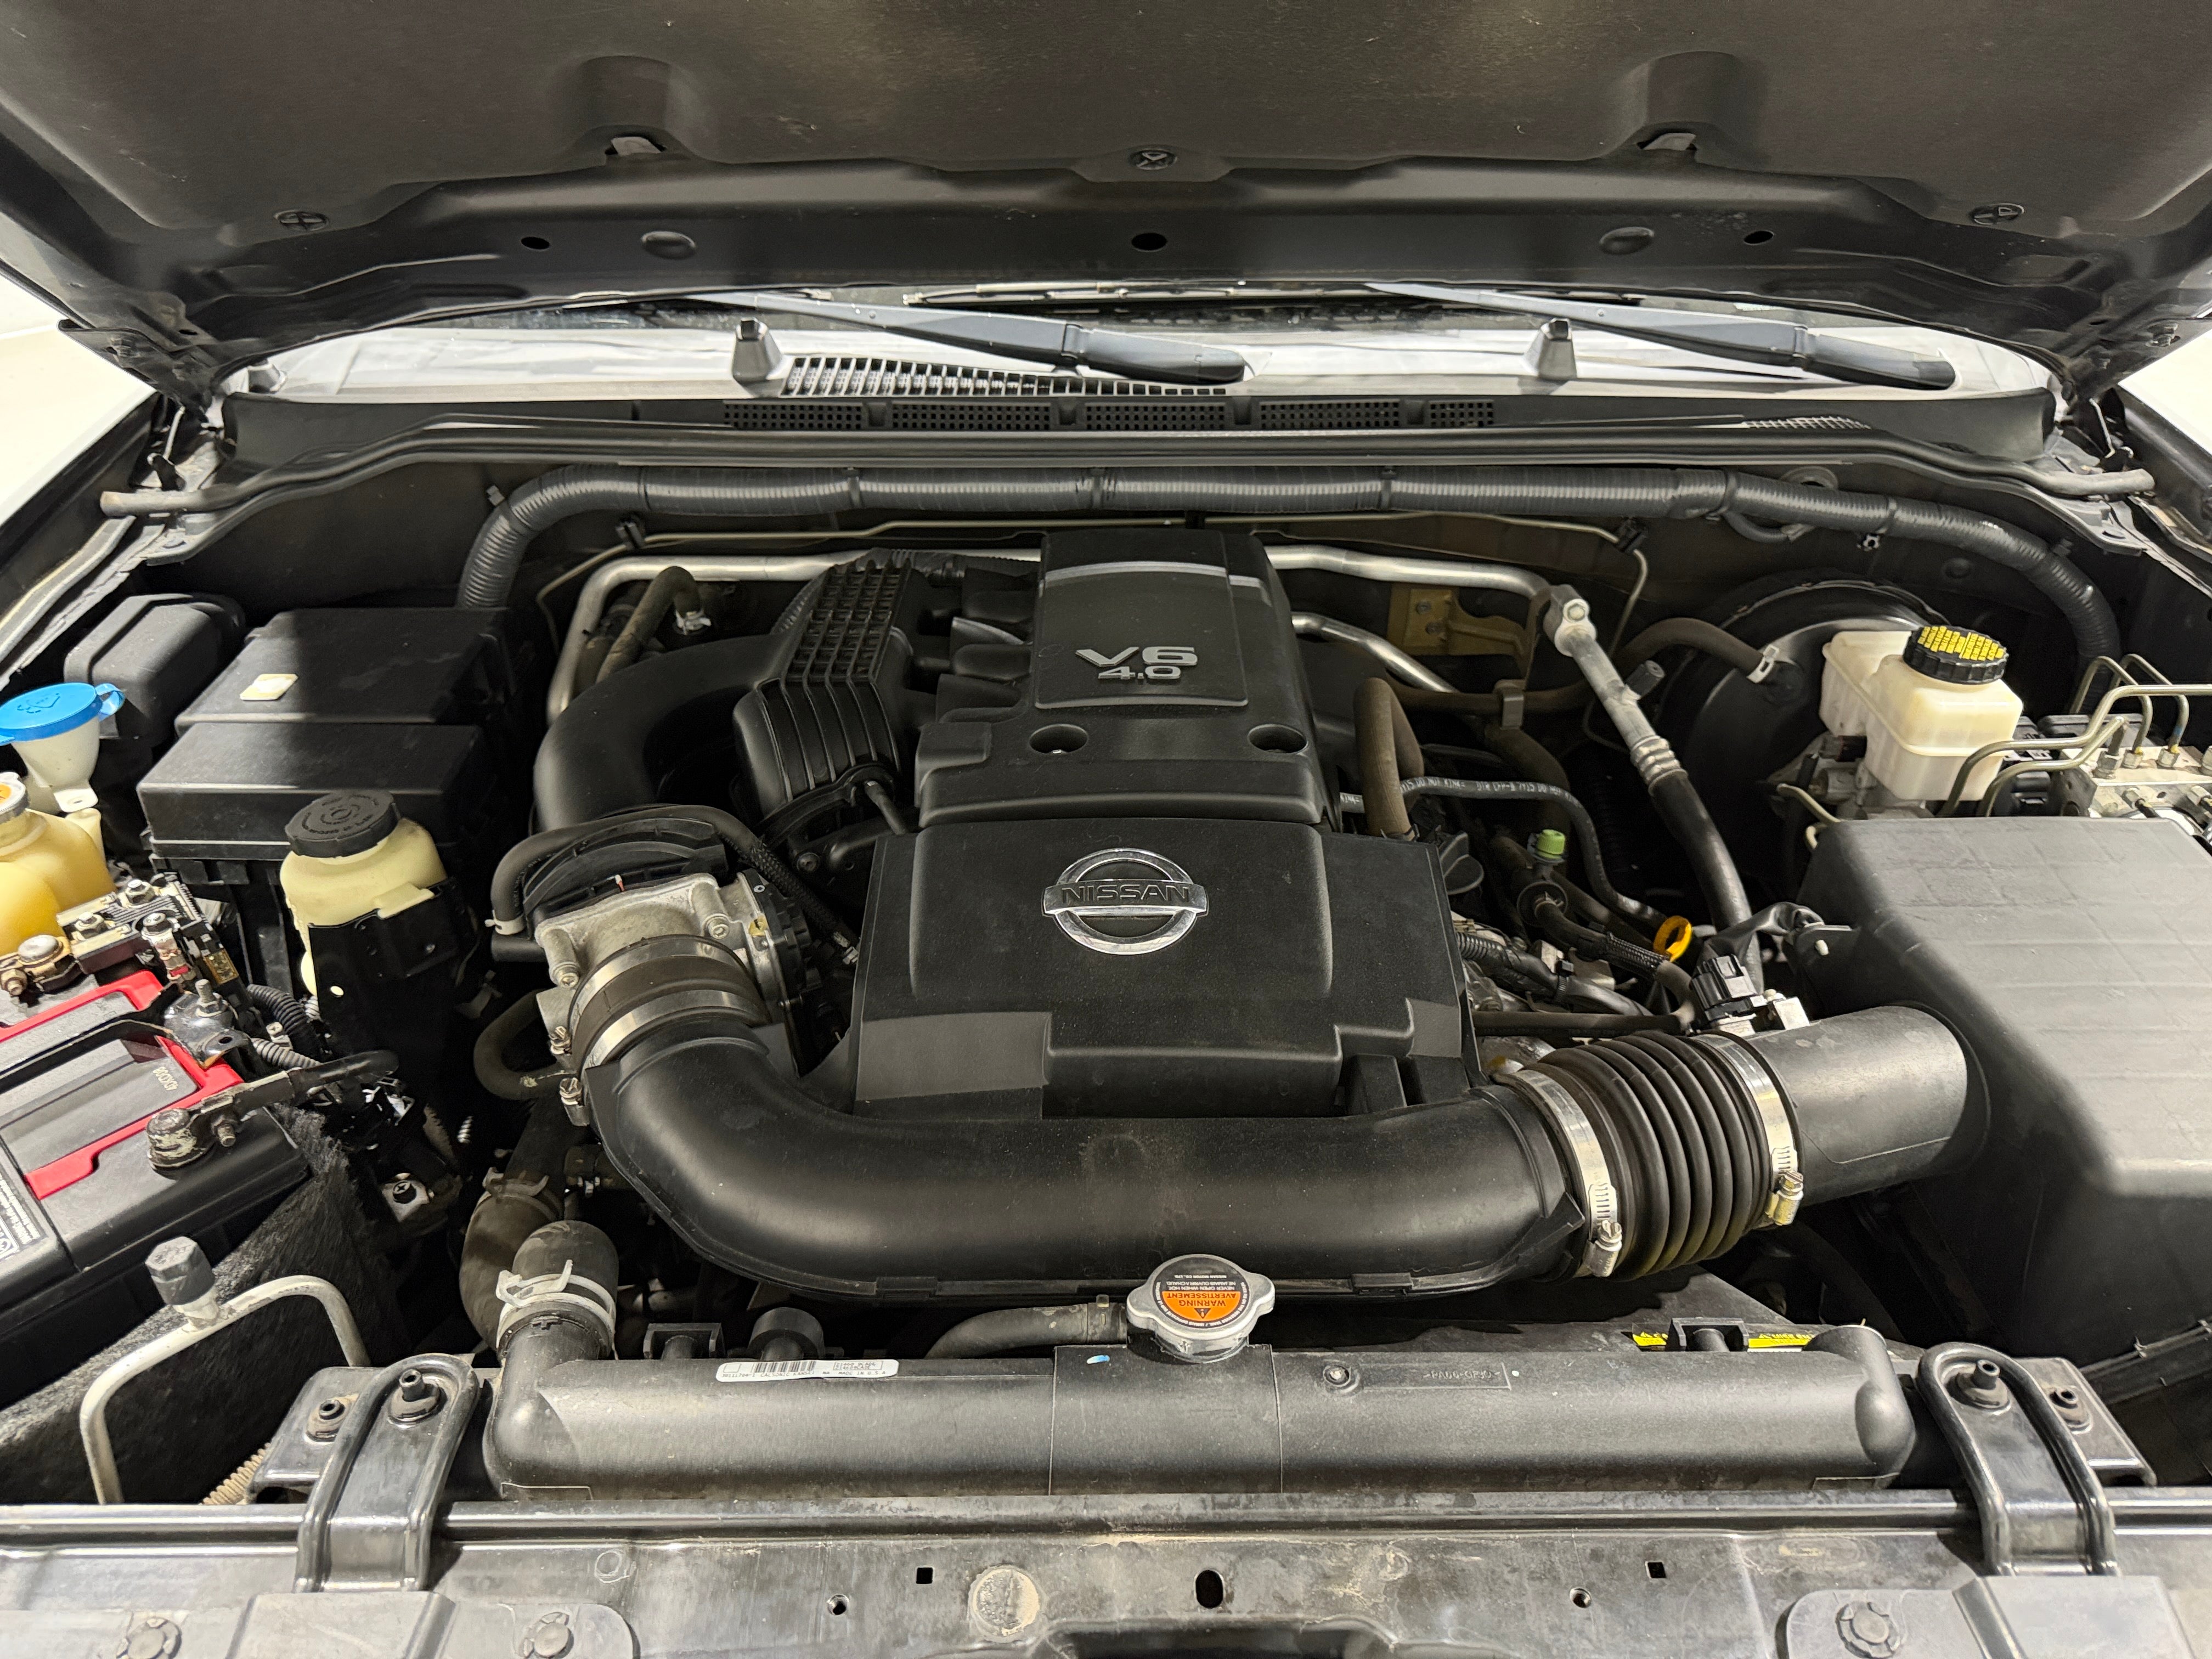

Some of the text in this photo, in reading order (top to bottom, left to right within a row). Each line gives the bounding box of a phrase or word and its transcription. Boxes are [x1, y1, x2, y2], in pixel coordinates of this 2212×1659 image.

[1075, 646, 1198, 668] V6
[1098, 665, 1181, 680] 4.0
[1062, 884, 1189, 904] NISSAN
